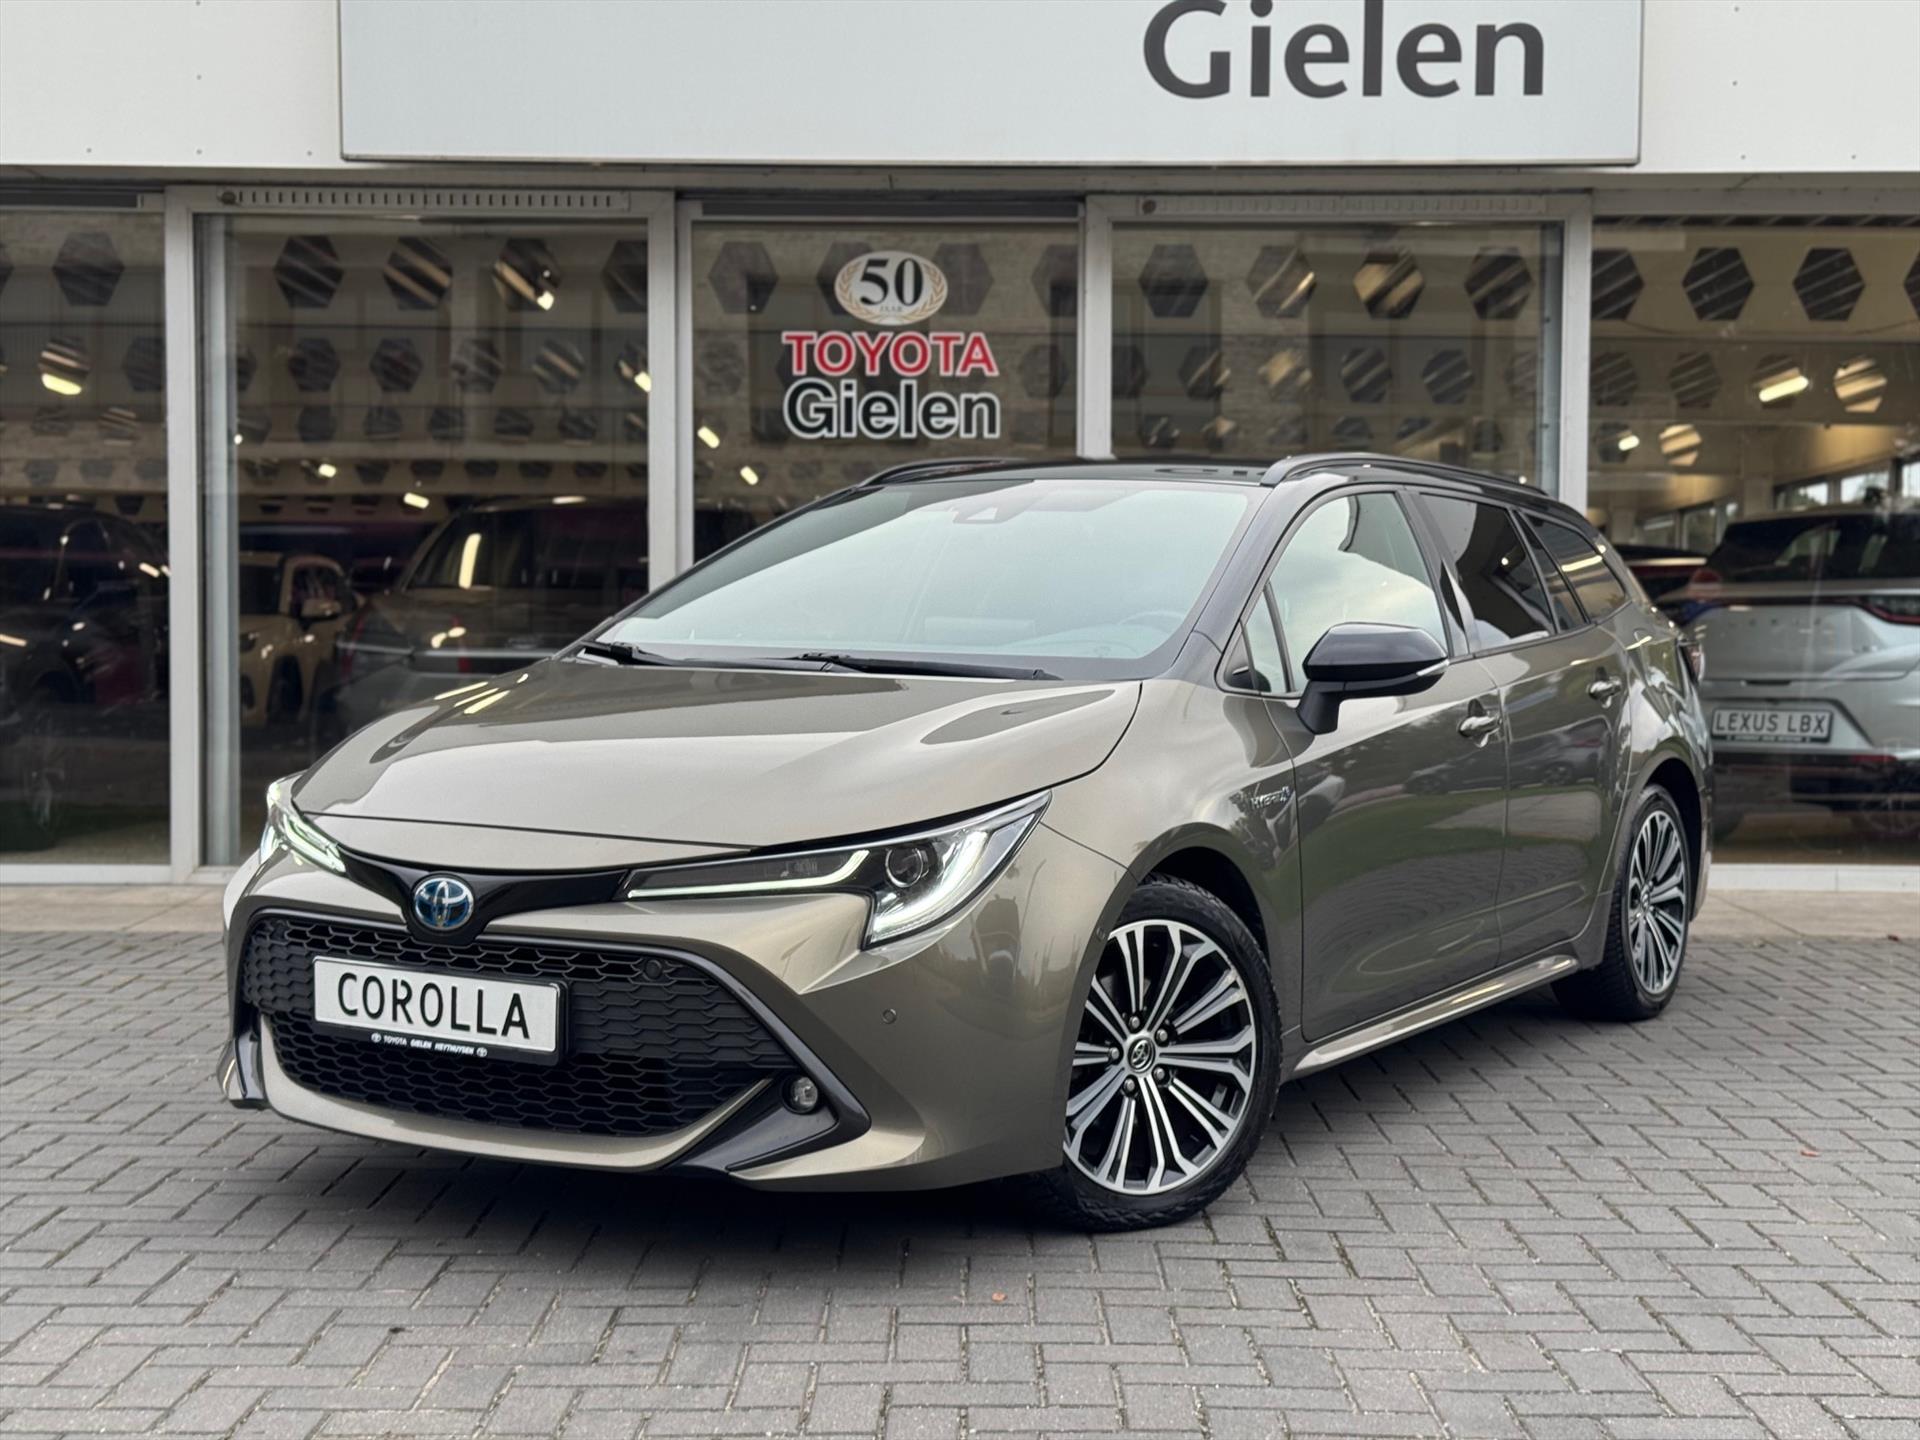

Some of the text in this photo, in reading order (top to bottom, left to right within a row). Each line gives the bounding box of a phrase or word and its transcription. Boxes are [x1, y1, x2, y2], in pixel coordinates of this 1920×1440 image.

[1143, 0, 1543, 98] Gielen
[859, 257, 924, 306] 50
[782, 331, 999, 376] TOYOTA
[783, 378, 1000, 439] Gielen
[1715, 713, 1826, 734] LEXUS LBX
[338, 972, 530, 1040] COROLLA
[383, 1034, 407, 1046] TOYOTA
